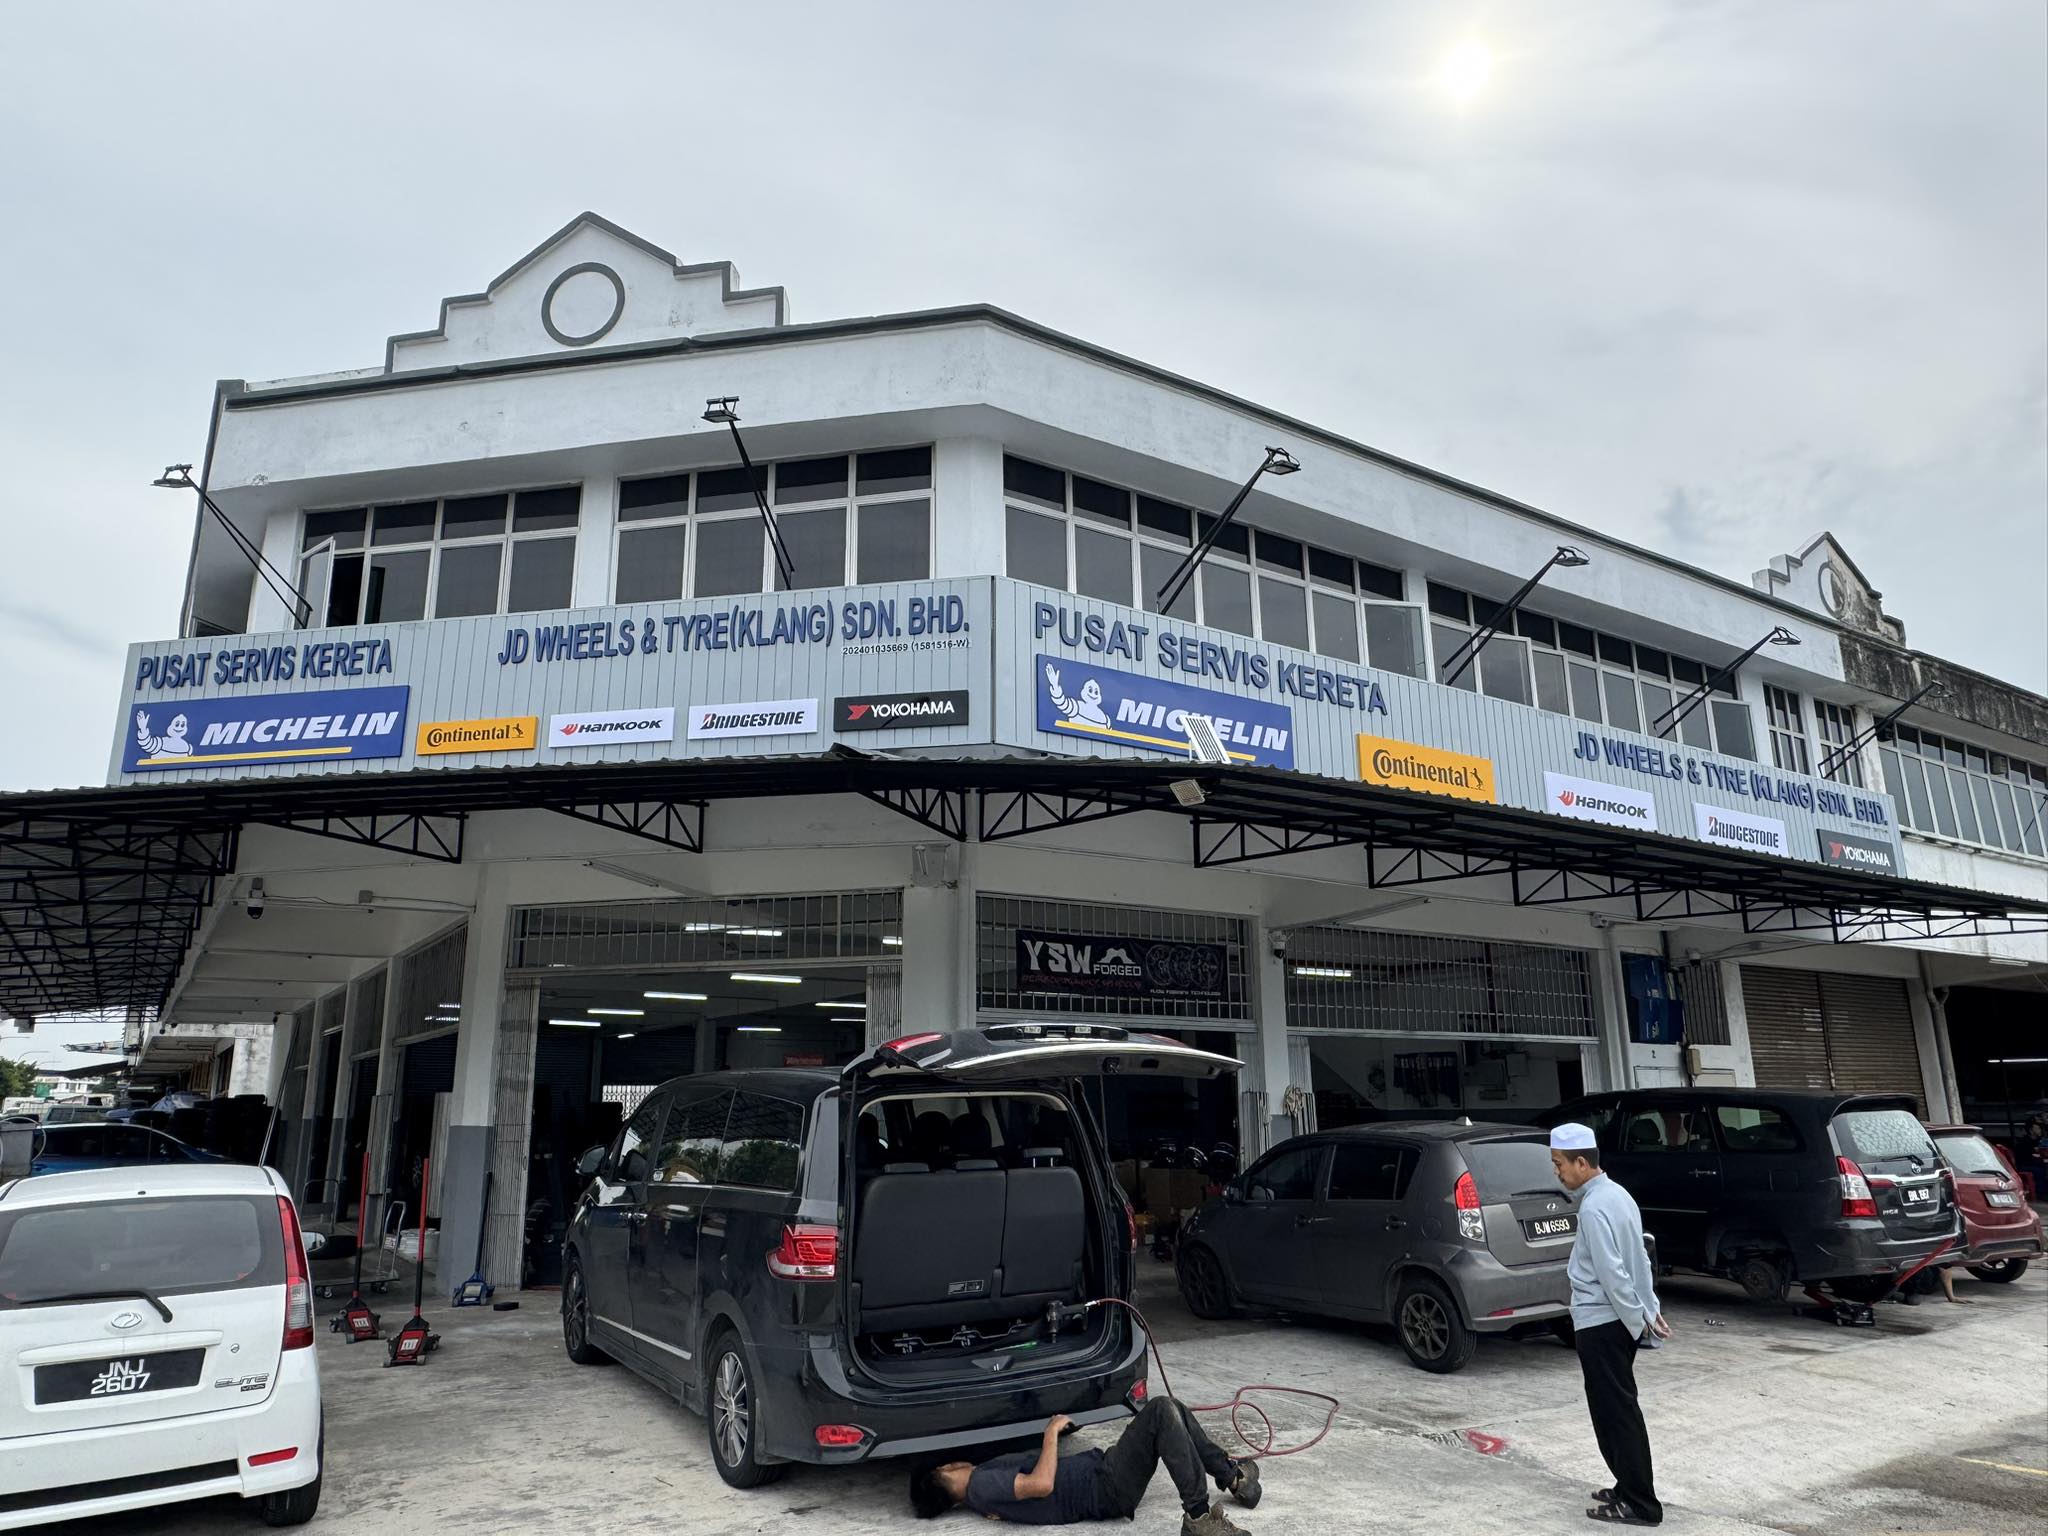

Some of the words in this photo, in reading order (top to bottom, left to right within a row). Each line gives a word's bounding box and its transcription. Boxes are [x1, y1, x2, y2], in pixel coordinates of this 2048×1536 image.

[498, 628, 529, 665] JD
[534, 619, 635, 662] WHEELS
[640, 617, 658, 654] &
[841, 600, 901, 640] SDN.
[908, 594, 970, 636] BHD.
[136, 652, 210, 690] PUSAT
[213, 645, 296, 685] SERVIS
[300, 639, 393, 679] KERETA
[1035, 601, 1149, 662] PUSAT
[1158, 632, 1270, 689] SERVIS
[1277, 659, 1389, 716] KERETA
[699, 711, 804, 731] BRIDGESTONE
[870, 699, 955, 719] YOKOHAMA
[1116, 698, 1288, 752] MICELIN
[200, 711, 400, 746] MICHELIN
[427, 724, 511, 748] Continental
[1372, 748, 1470, 789] Continental
[1574, 731, 1601, 763] JD
[1603, 738, 1683, 782] WHEELS
[1688, 756, 1702, 785] &
[1702, 760, 1749, 796] TYRE
[1751, 772, 1815, 815] (KLANG)
[1816, 787, 1852, 818] SDN.
[1856, 801, 1889, 827] BHD.
[1708, 816, 1779, 849] BRIDGESTONE
[1842, 845, 1891, 868] YOKOHAMA
[1022, 939, 1092, 975] YSW
[1093, 964, 1142, 977] FORGED
[90, 1372, 151, 1395] 2607
[99, 1358, 147, 1379] JNJ
